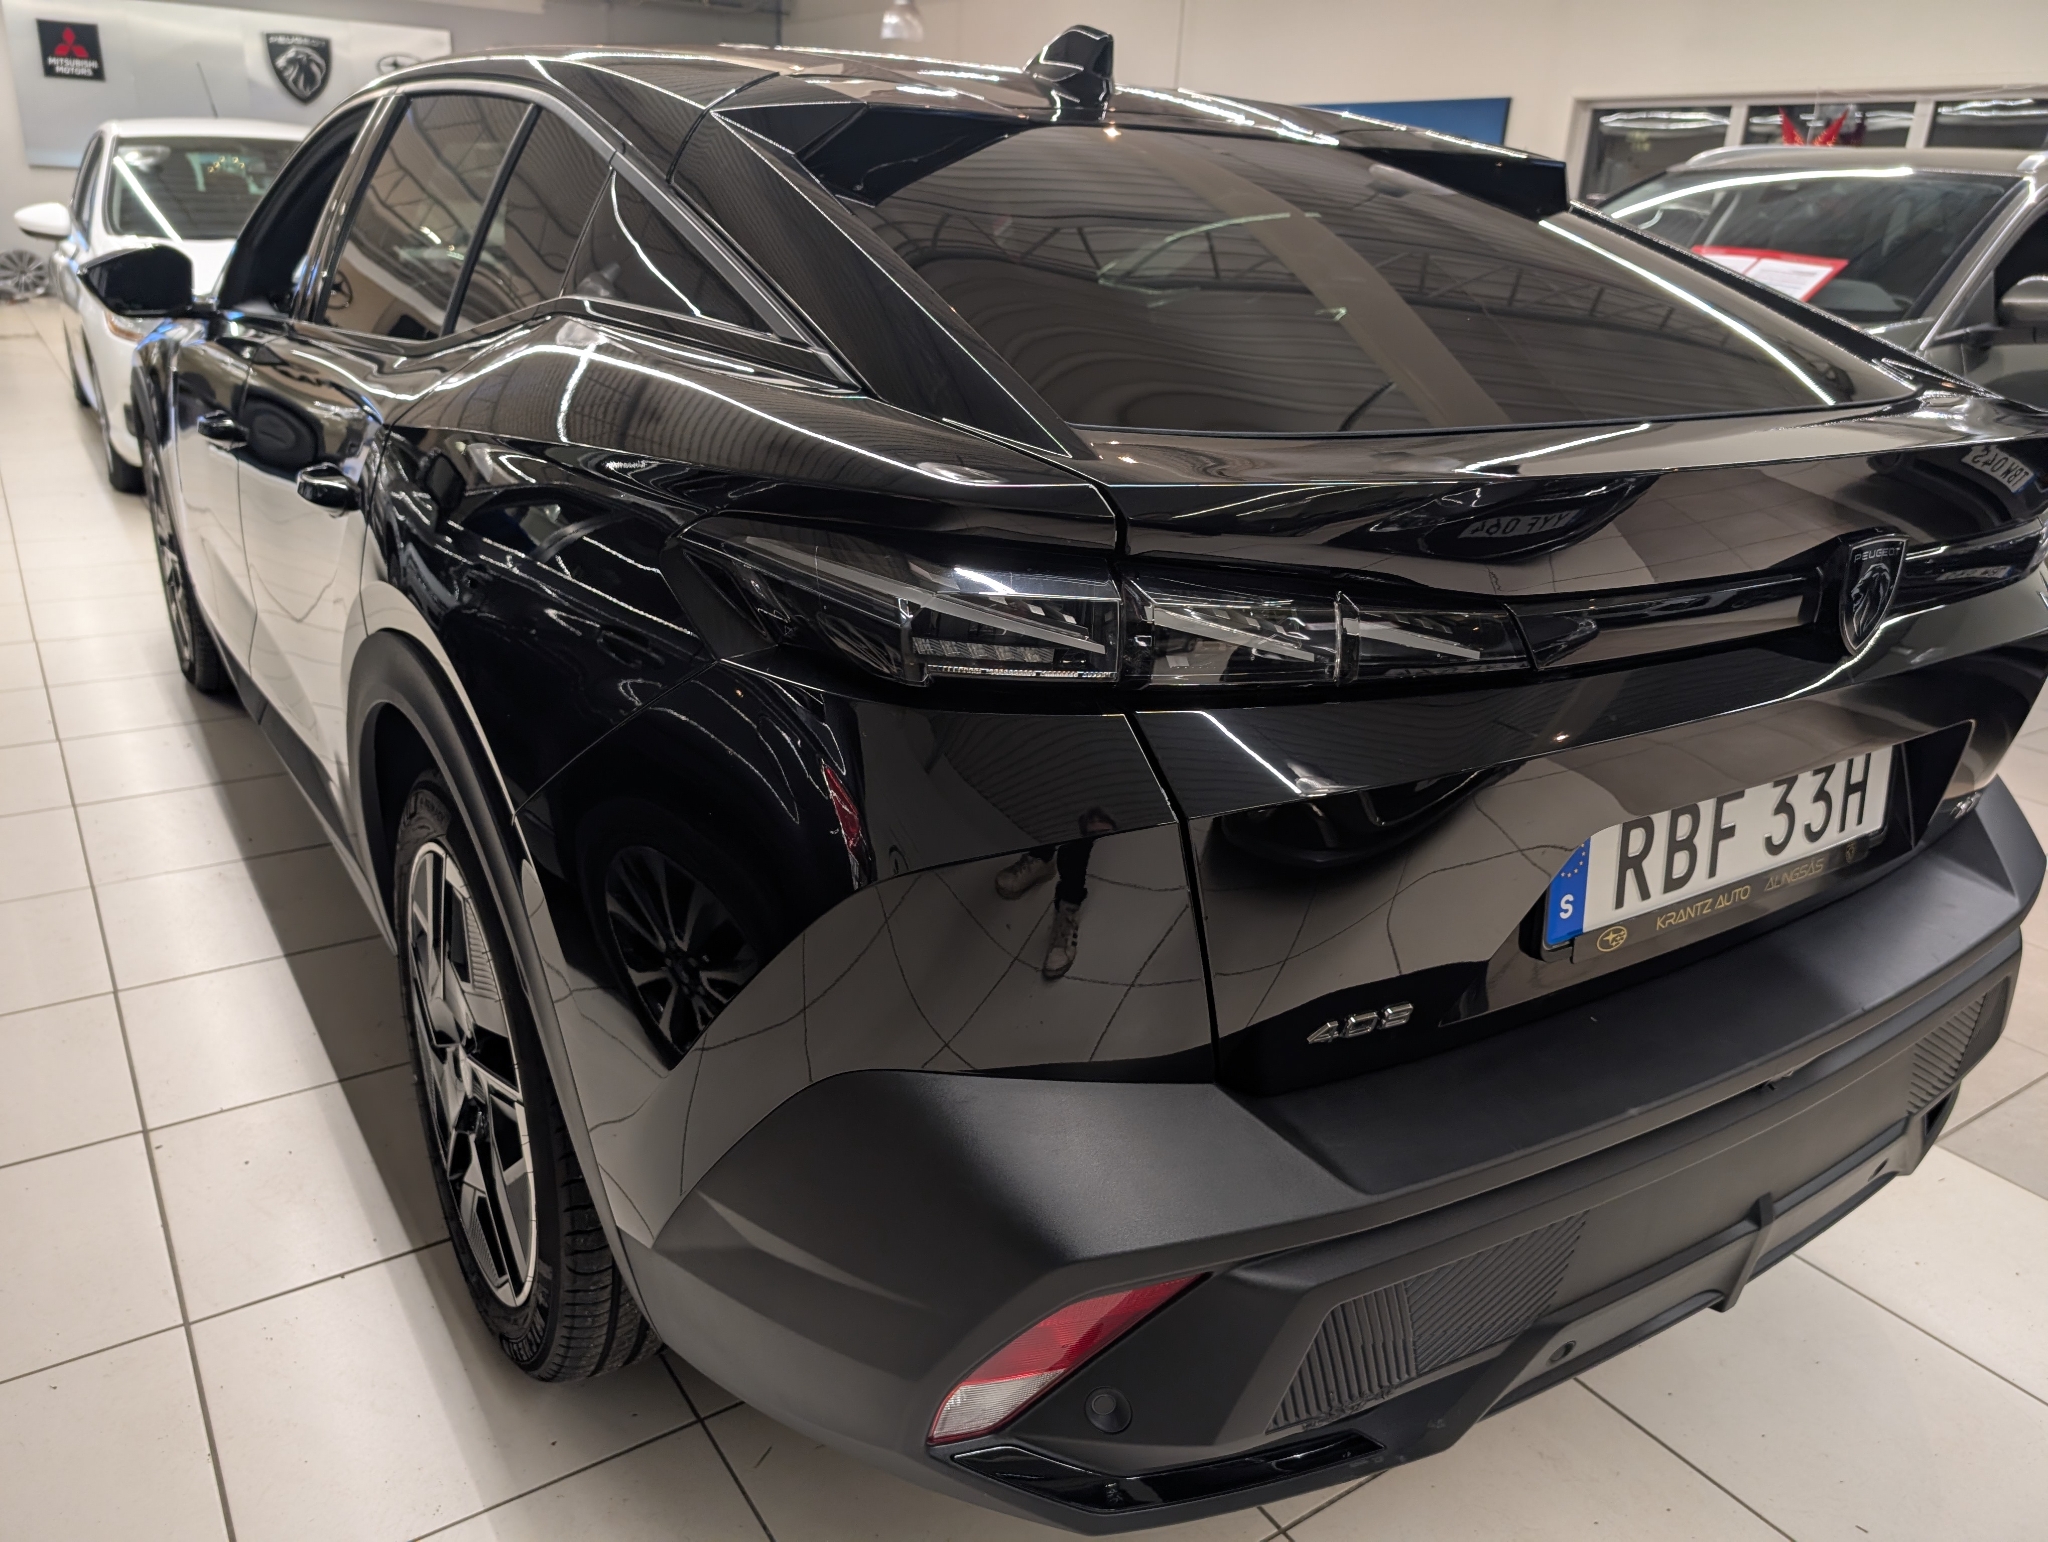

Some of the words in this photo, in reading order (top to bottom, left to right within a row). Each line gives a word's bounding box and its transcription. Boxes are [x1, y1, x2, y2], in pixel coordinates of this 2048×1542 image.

[47, 56, 99, 69] MITSUBISHI
[55, 66, 94, 76] MOTORS
[1853, 547, 1901, 562] PEUGEOT
[1614, 789, 1746, 910] RBF
[1764, 752, 1872, 856] 33H
[1559, 893, 1575, 920] S
[1655, 897, 1713, 930] KRANTZ
[1714, 885, 1751, 910] AUTO
[1306, 1003, 1414, 1045] 408
